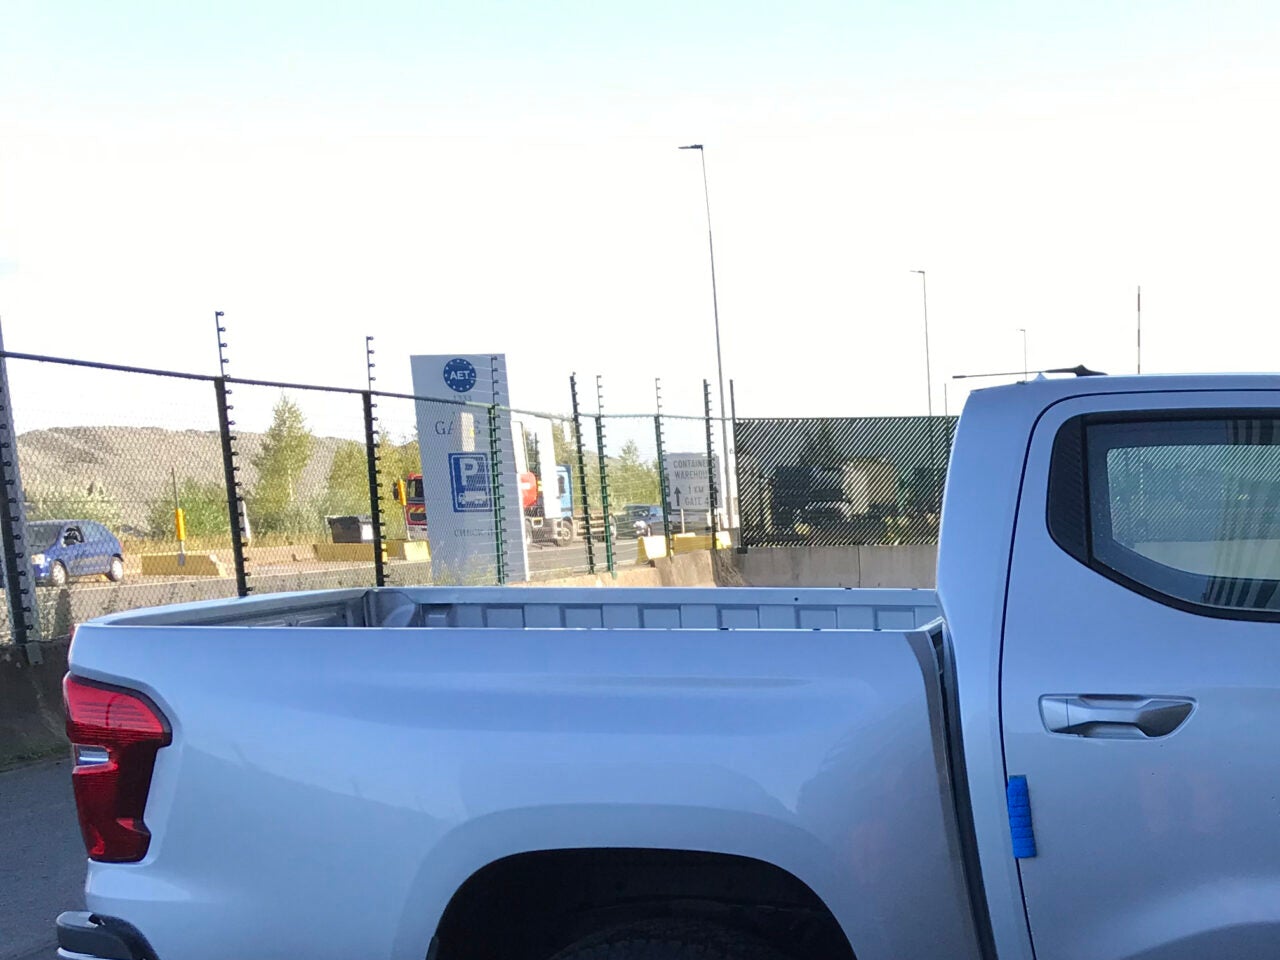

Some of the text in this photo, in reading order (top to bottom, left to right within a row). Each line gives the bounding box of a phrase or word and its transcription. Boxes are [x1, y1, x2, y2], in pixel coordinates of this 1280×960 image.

[449, 370, 471, 380] AET
[673, 459, 716, 469] CONTAINES
[460, 458, 479, 486] P
